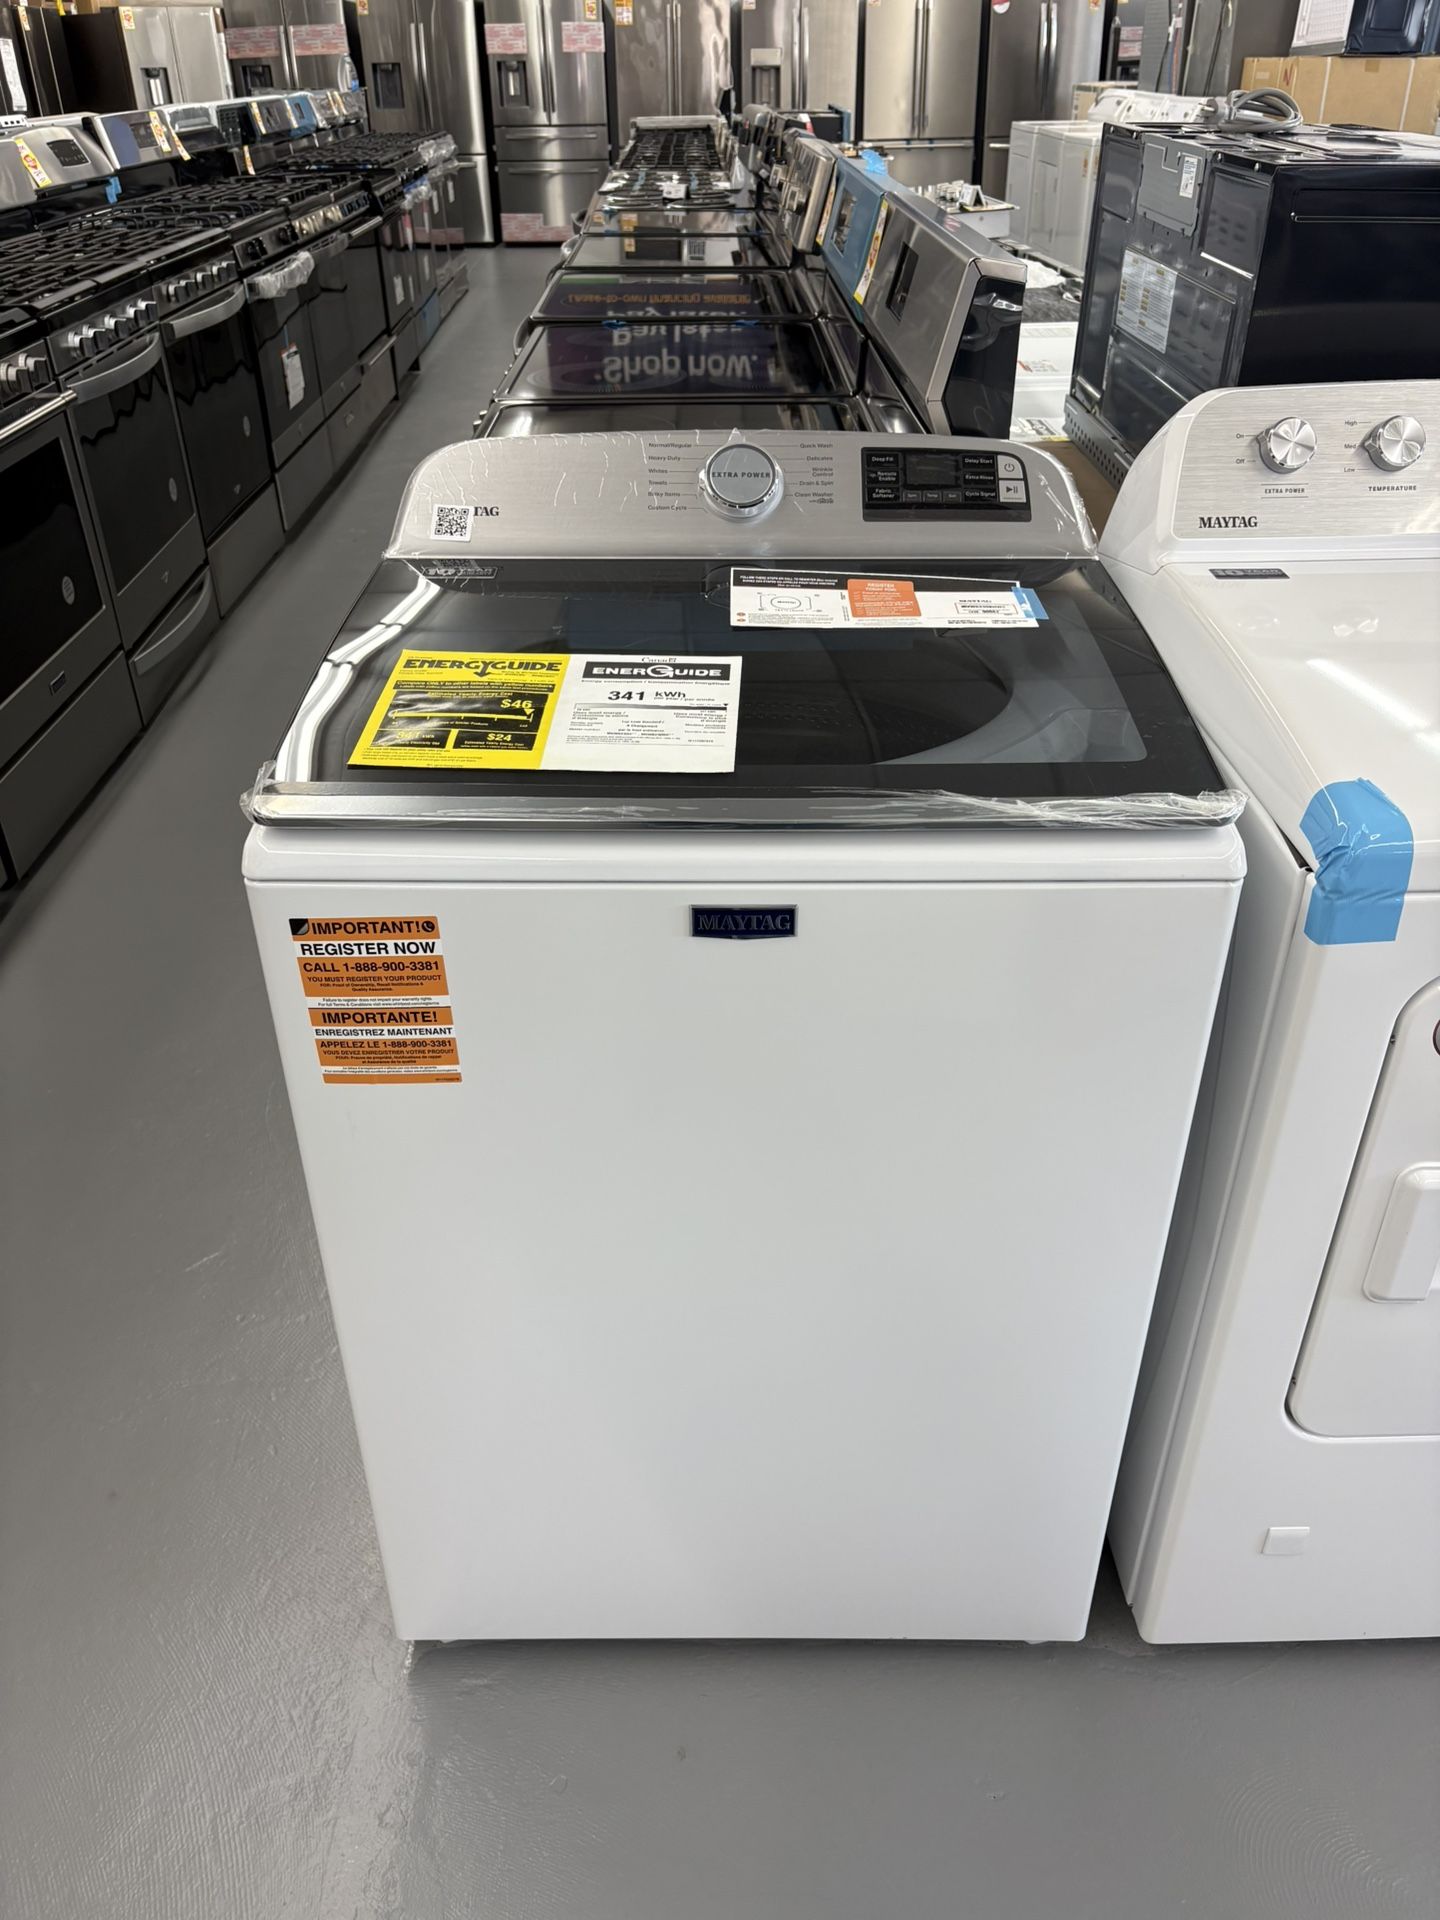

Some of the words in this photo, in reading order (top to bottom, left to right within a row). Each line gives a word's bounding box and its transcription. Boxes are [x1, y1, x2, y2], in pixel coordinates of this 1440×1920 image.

[473, 506, 500, 516] TAG
[1198, 516, 1258, 528] MAYTAG
[403, 659, 562, 677] ENERGYGUIDE
[592, 664, 722, 678] ENERGUIDE
[608, 691, 645, 700] 341
[500, 699, 532, 709] $46
[486, 733, 512, 742] $24
[312, 920, 420, 935] IMPORTANT!
[698, 914, 791, 930] MAYTAG
[300, 942, 389, 956] REGISTER
[394, 941, 436, 954] NOW
[303, 962, 340, 972] CALL
[343, 961, 439, 972] 1-888-900-3381
[322, 1011, 438, 1024] IMPORTANTE!
[315, 1028, 385, 1036] ENREGISTREZ
[387, 1027, 453, 1036] MAINTENANT
[382, 1040, 452, 1048] 1-888-900-3381
